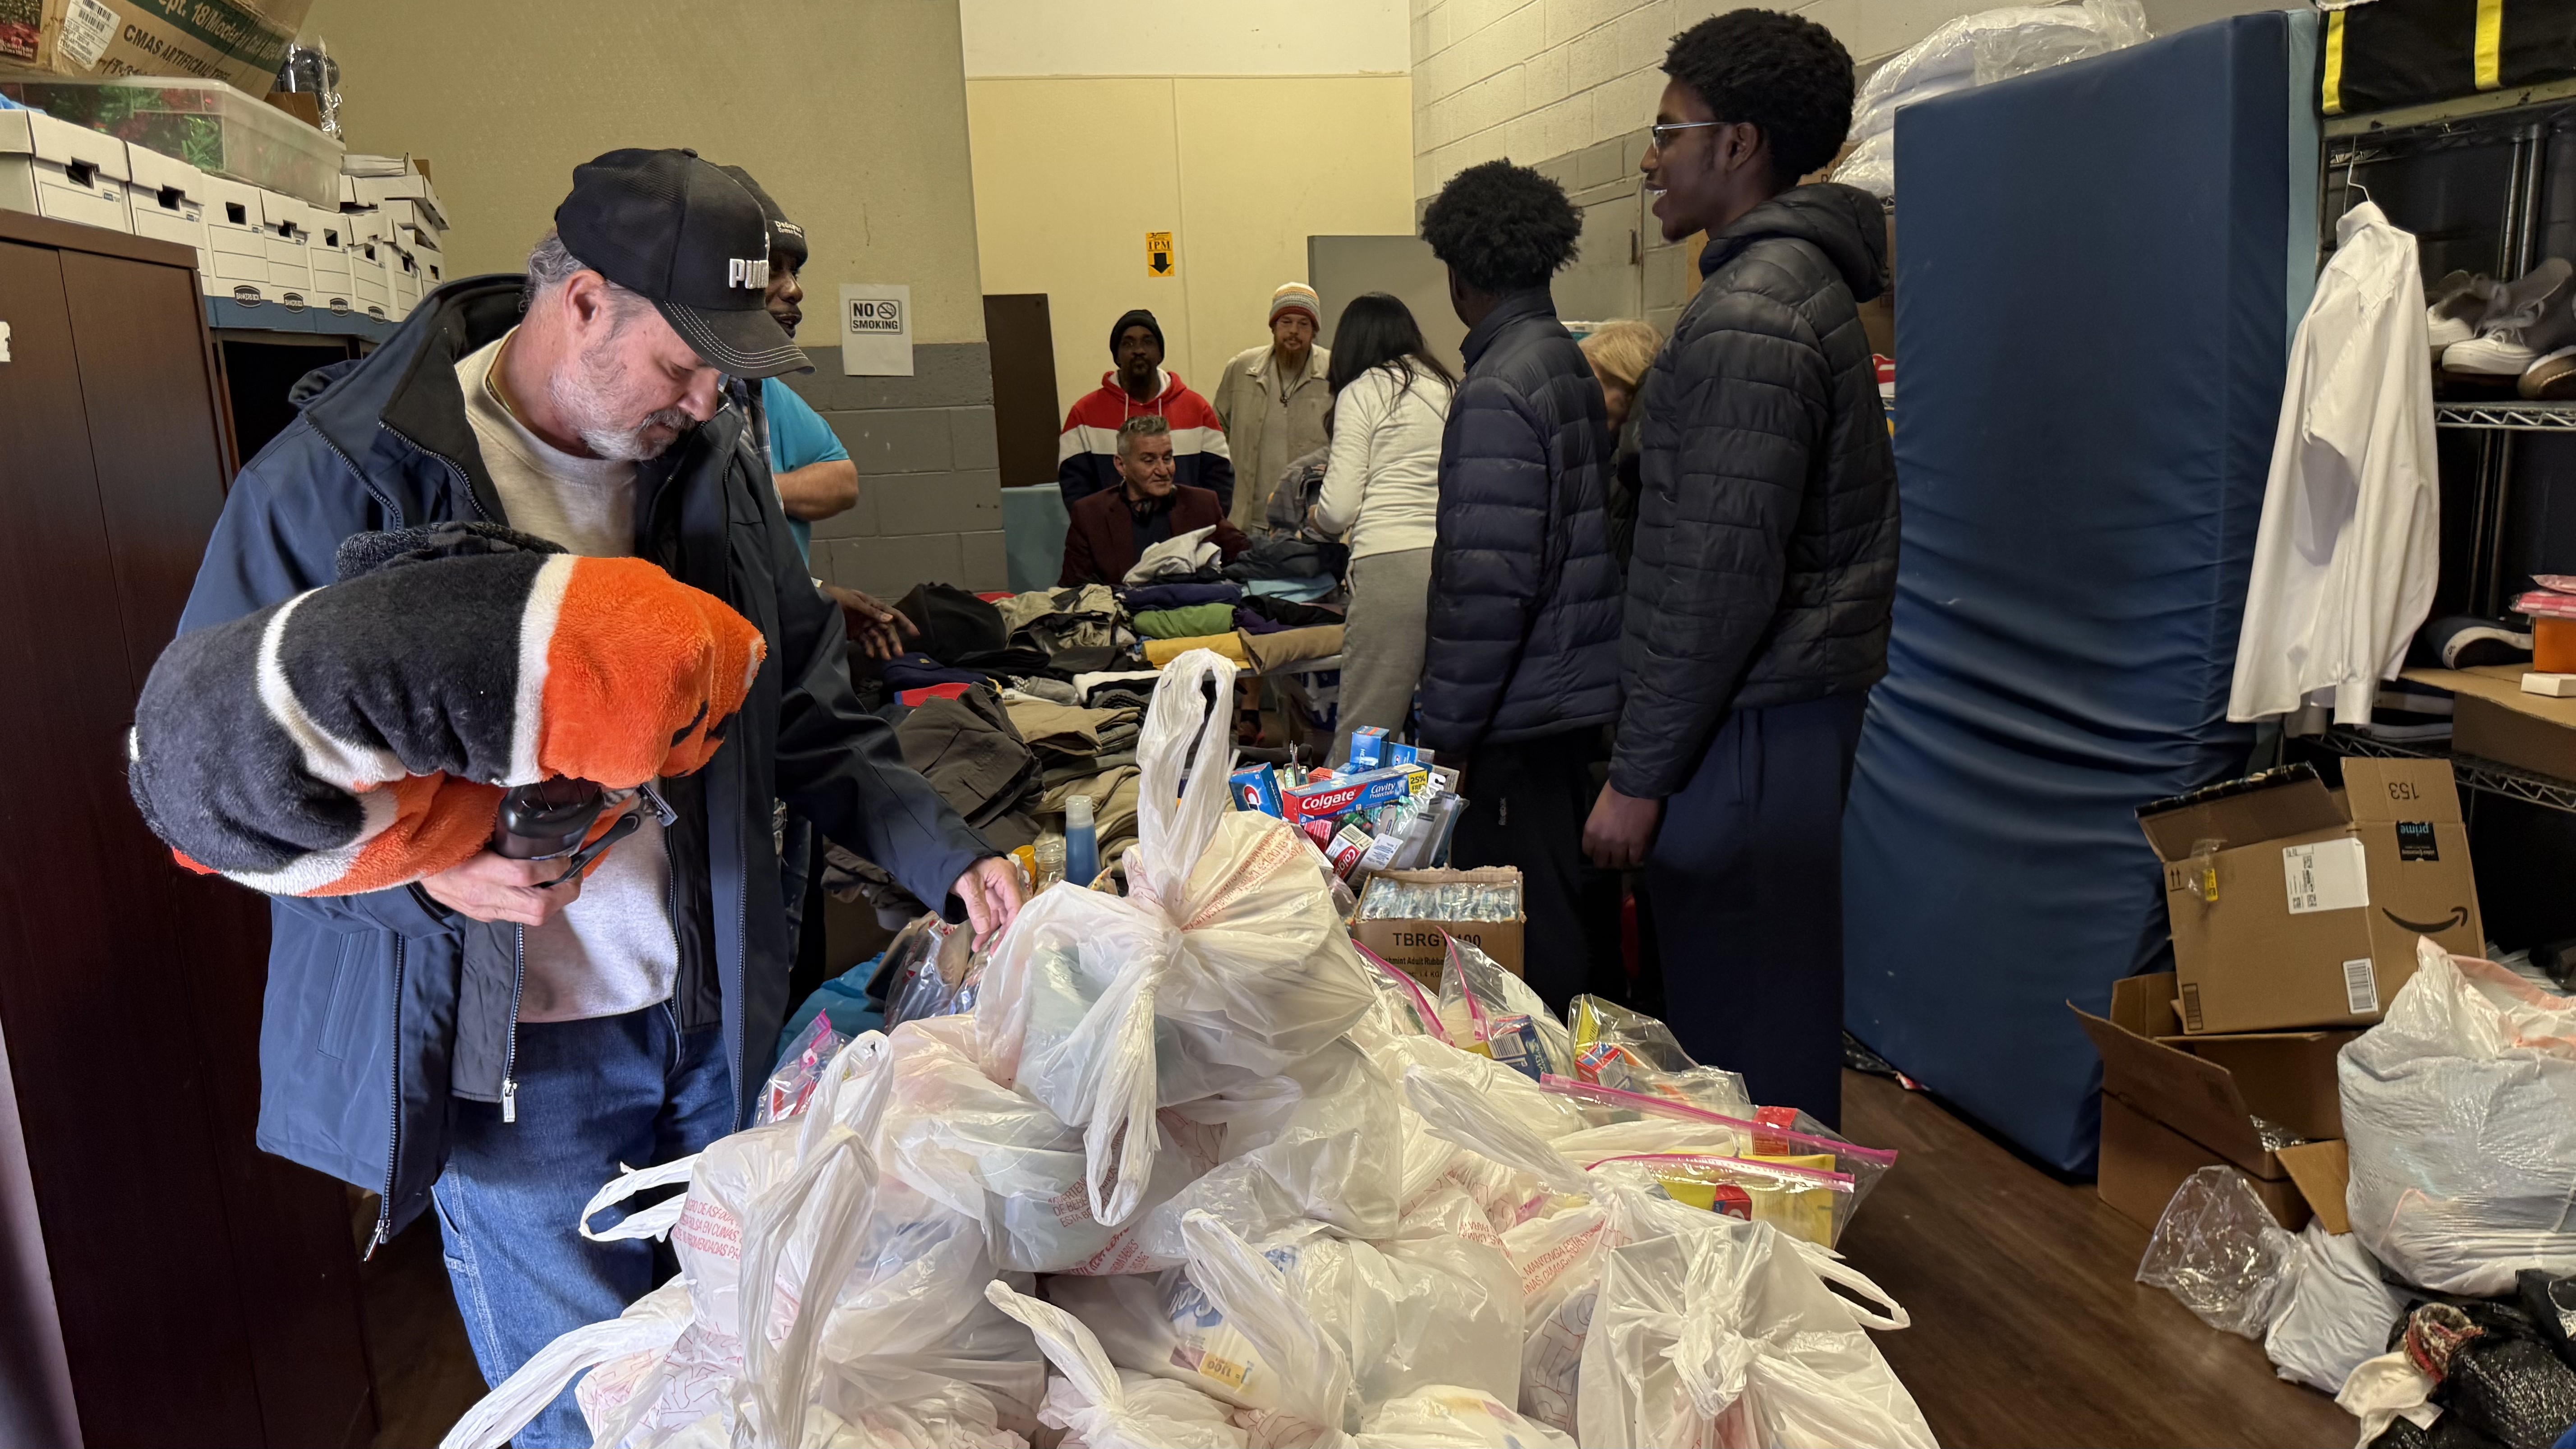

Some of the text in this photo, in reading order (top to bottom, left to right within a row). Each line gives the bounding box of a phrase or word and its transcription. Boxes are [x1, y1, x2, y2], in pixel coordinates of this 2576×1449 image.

[123, 24, 163, 55] CMAS
[853, 303, 874, 317] NO
[853, 320, 898, 330] SMOKING
[1410, 775, 1426, 784] 25%
[1371, 782, 1396, 793] Cavity
[2388, 782, 2420, 800] 153
[1302, 790, 1354, 810] Colgate
[1370, 790, 1395, 799] Protection
[2400, 823, 2429, 836] prime
[698, 1202, 708, 1215] DE
[1053, 1204, 1064, 1216] DE
[1060, 1214, 1082, 1227] ESTA
[702, 1221, 713, 1234] EN
[712, 1224, 740, 1244] CUNAS,
[1523, 1246, 1565, 1276] MANTENGA
